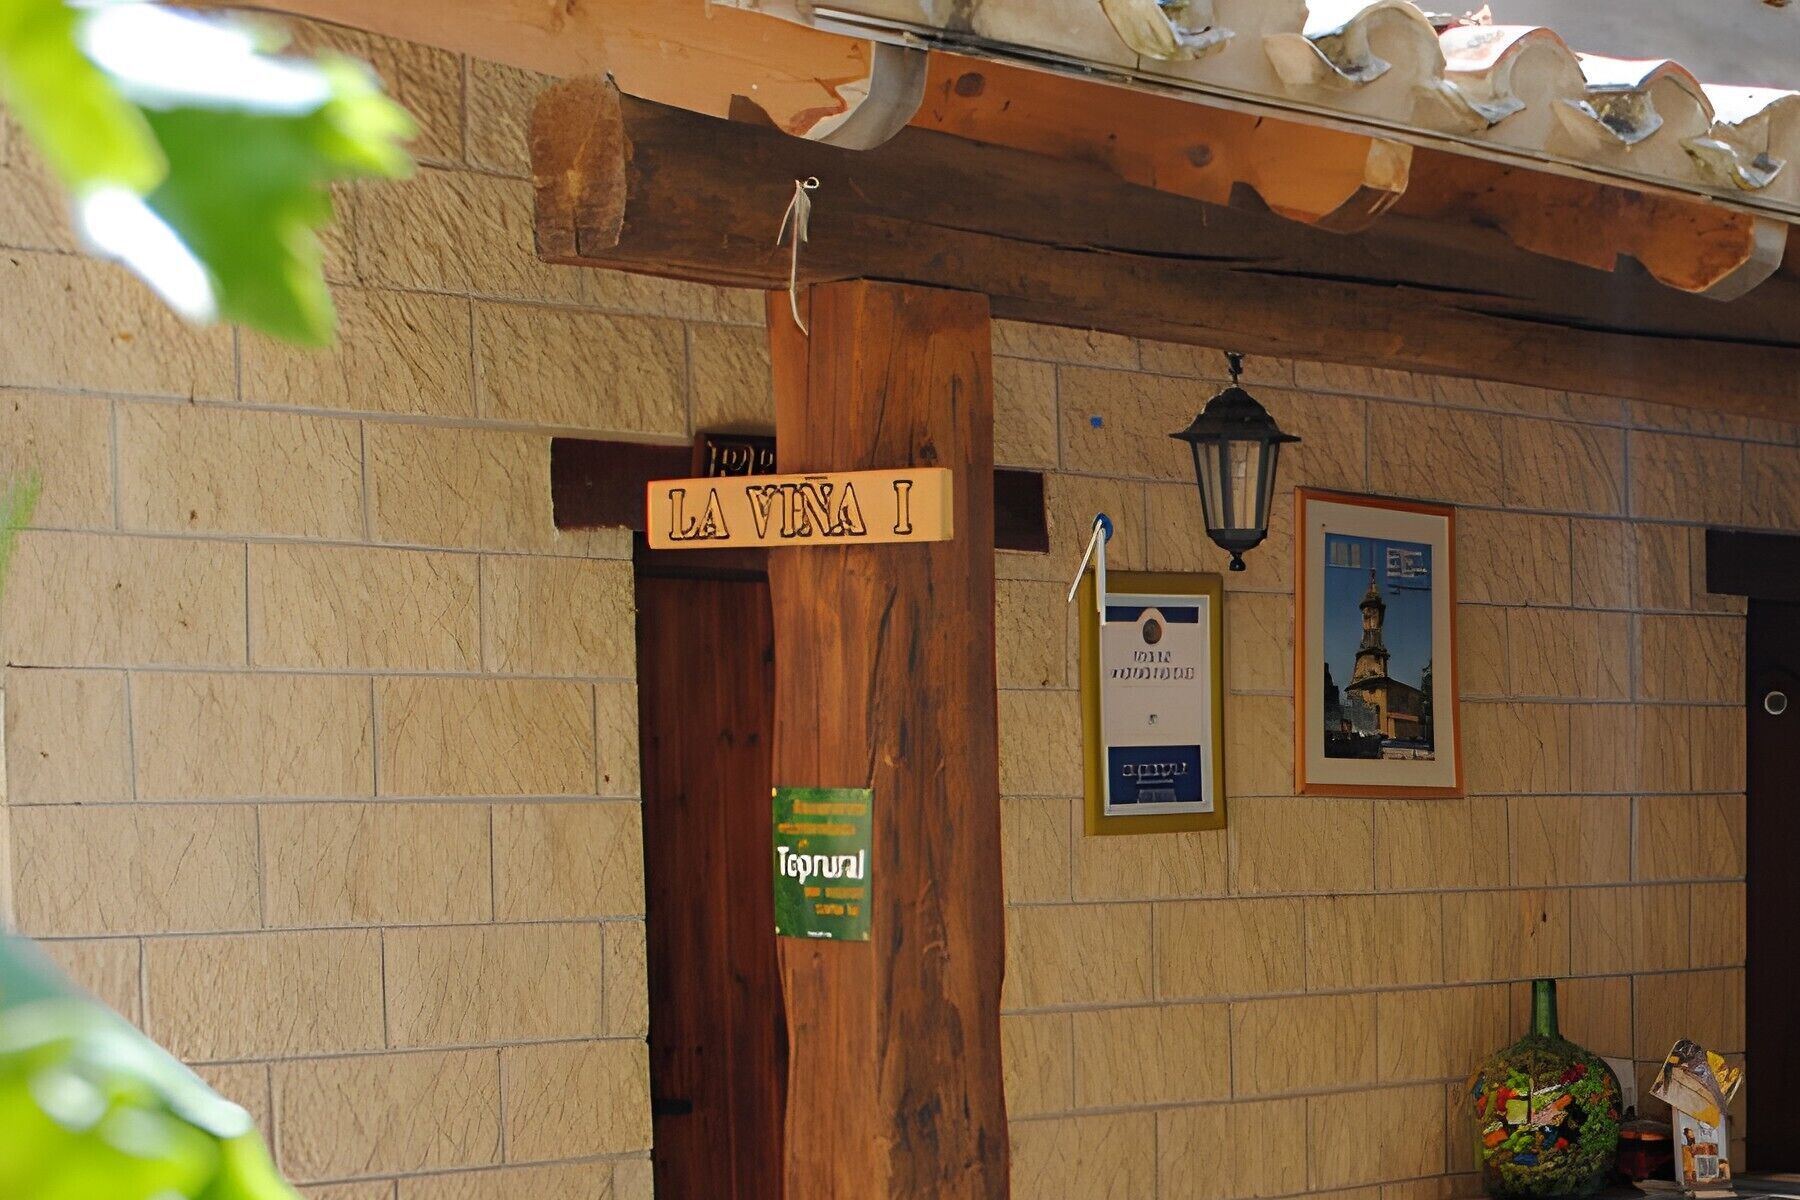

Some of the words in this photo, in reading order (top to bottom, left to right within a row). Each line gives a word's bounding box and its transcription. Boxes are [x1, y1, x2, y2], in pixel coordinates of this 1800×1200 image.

[668, 488, 731, 541] LA
[892, 479, 914, 536] I
[776, 846, 865, 885] Toprural
